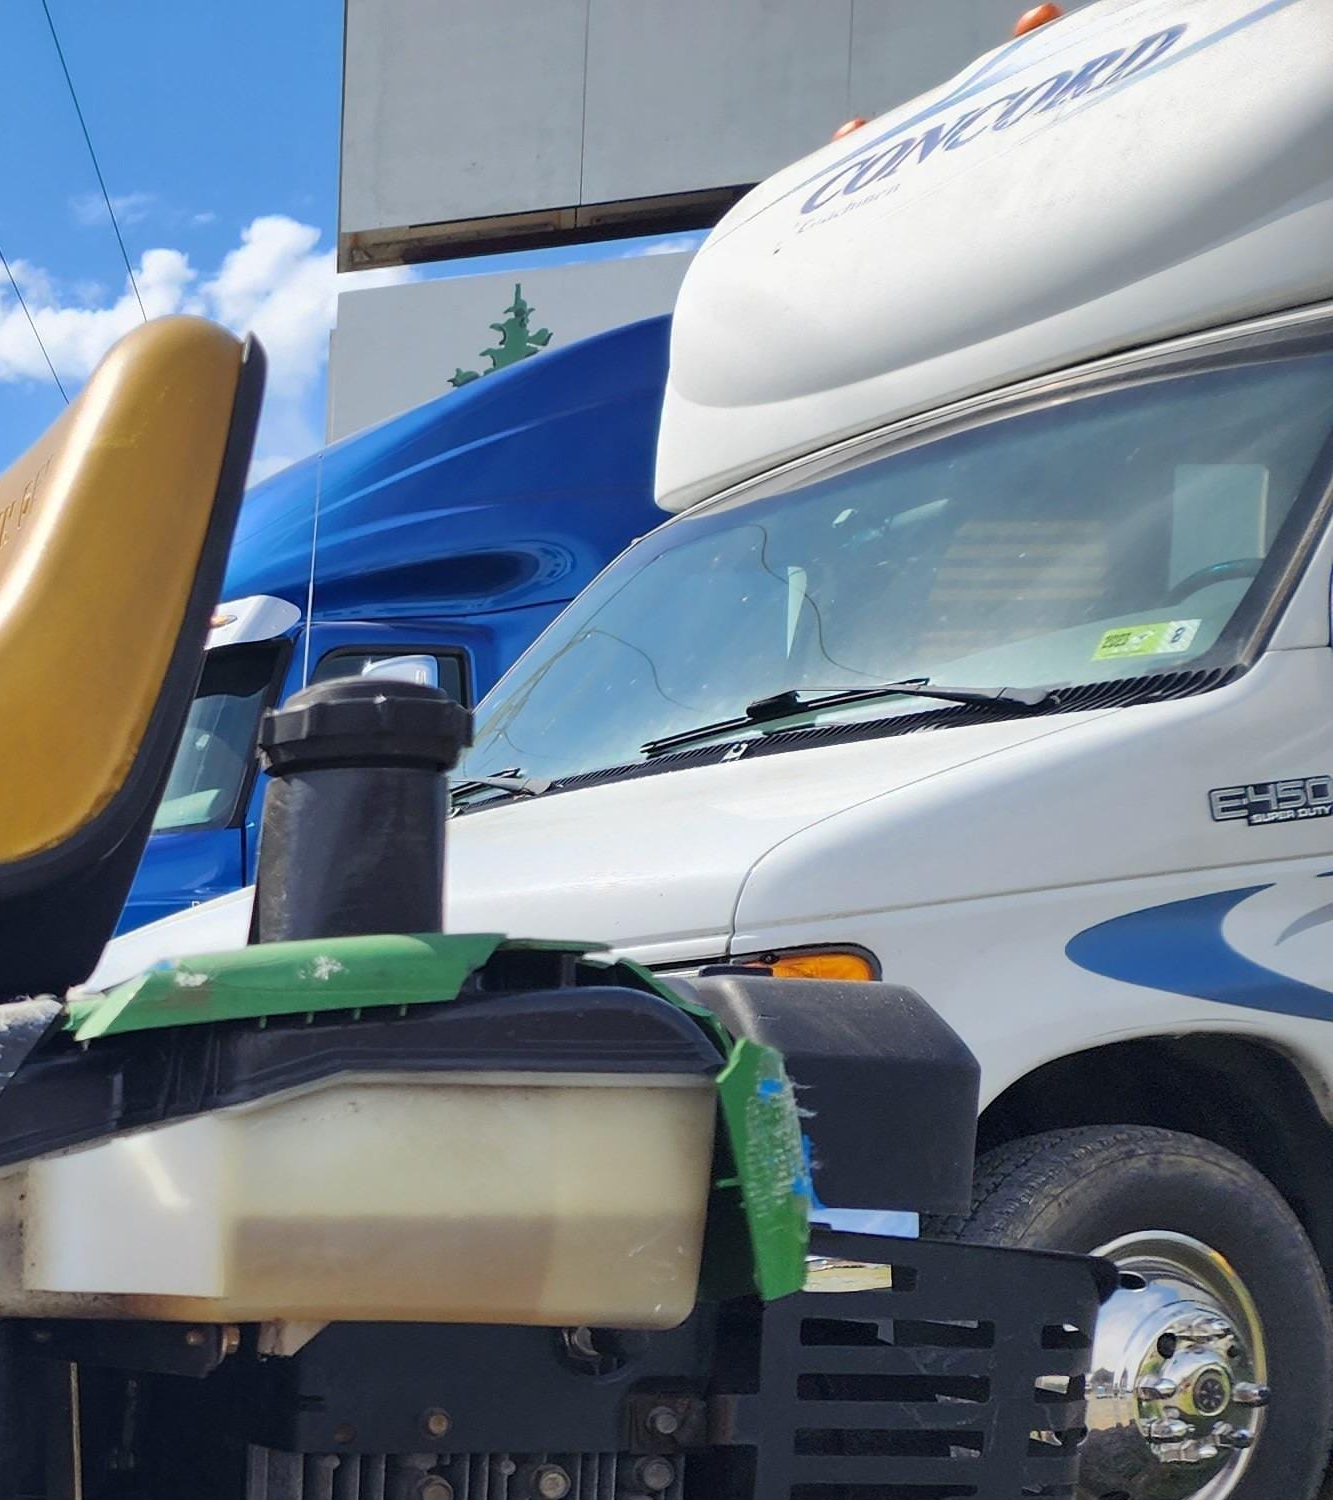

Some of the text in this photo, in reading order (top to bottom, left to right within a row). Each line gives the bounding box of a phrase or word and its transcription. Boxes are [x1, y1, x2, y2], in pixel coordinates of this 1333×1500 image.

[800, 22, 1189, 214] CONCORD
[1251, 805, 1332, 824] SUPER DUTY
